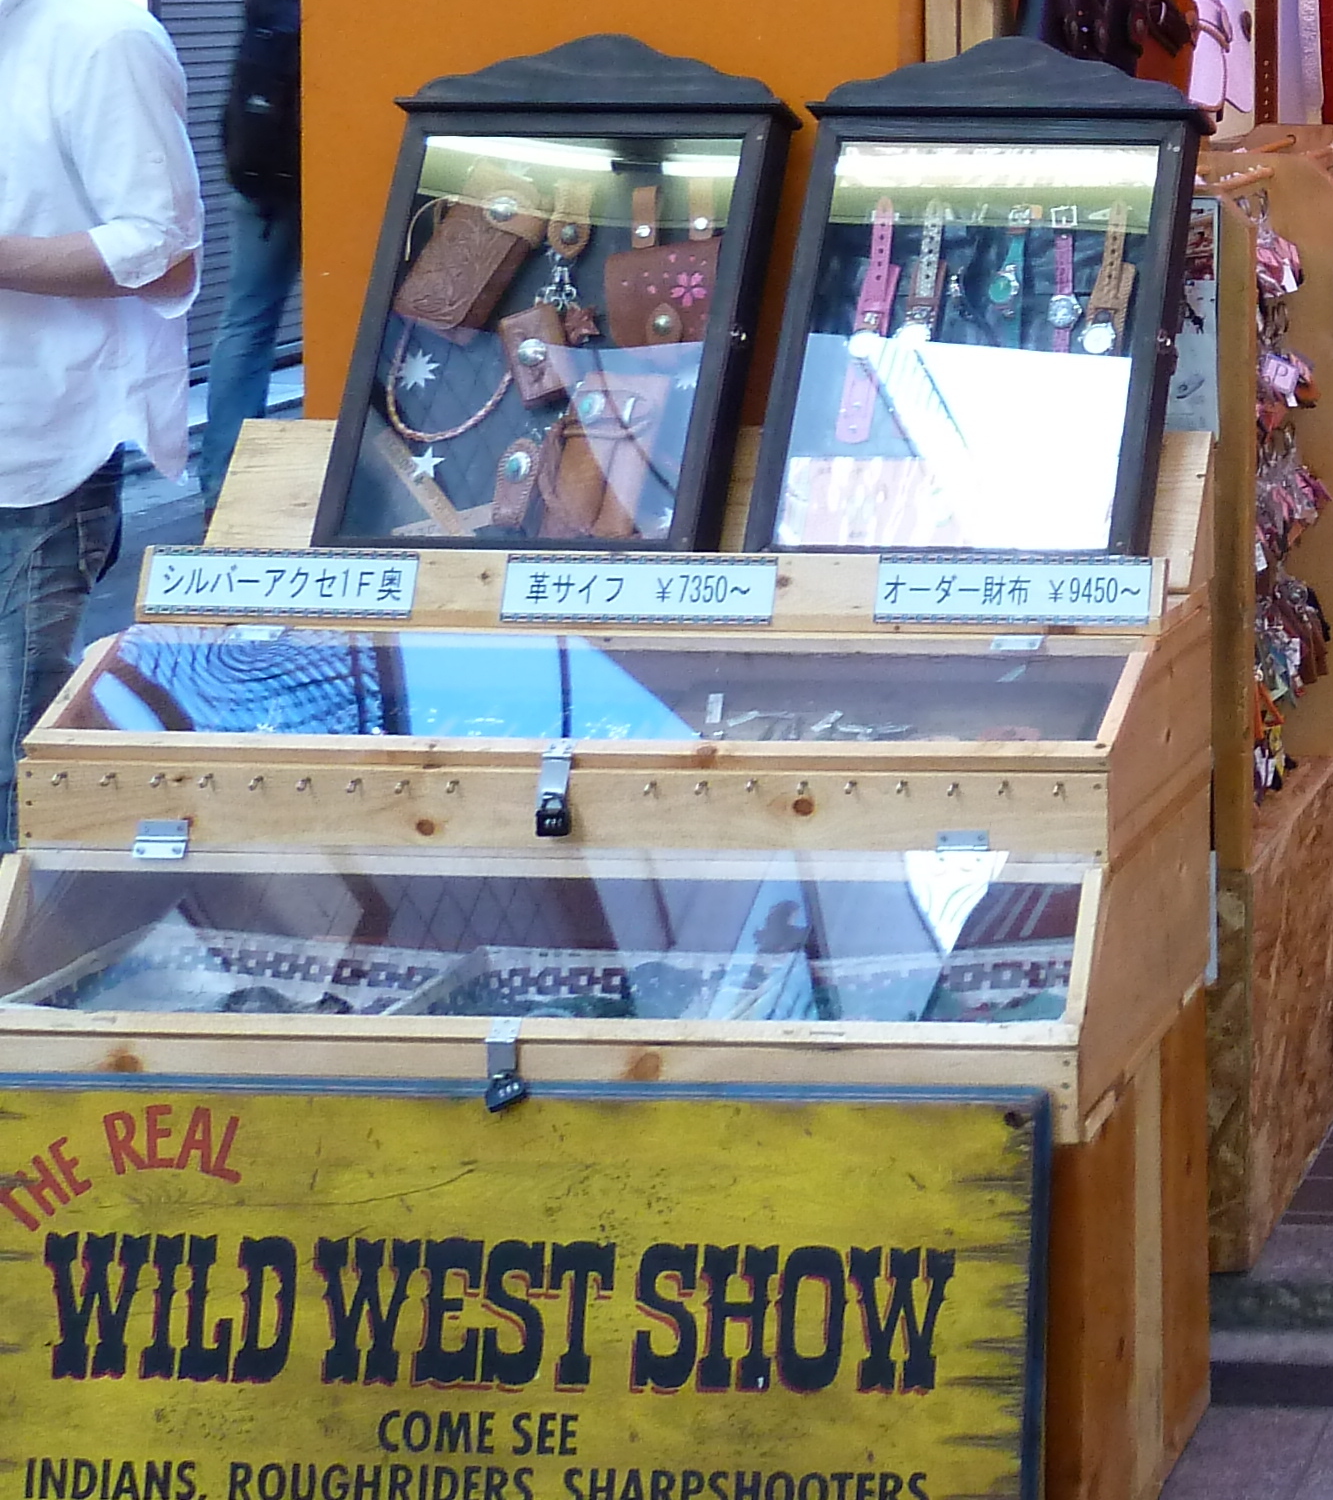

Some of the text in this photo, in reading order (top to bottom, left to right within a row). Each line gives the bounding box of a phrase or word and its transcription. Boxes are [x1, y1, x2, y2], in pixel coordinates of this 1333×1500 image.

[525, 571, 752, 604] 革サイフ ¥7350～
[884, 574, 1142, 606] オーダー財布 ¥9450～
[0, 1103, 242, 1232] THE REAL
[44, 1231, 955, 1396] WILD WEST SHOW
[379, 1410, 578, 1457] COME SEE
[564, 1466, 928, 1500] SHARPSHOOTERS
